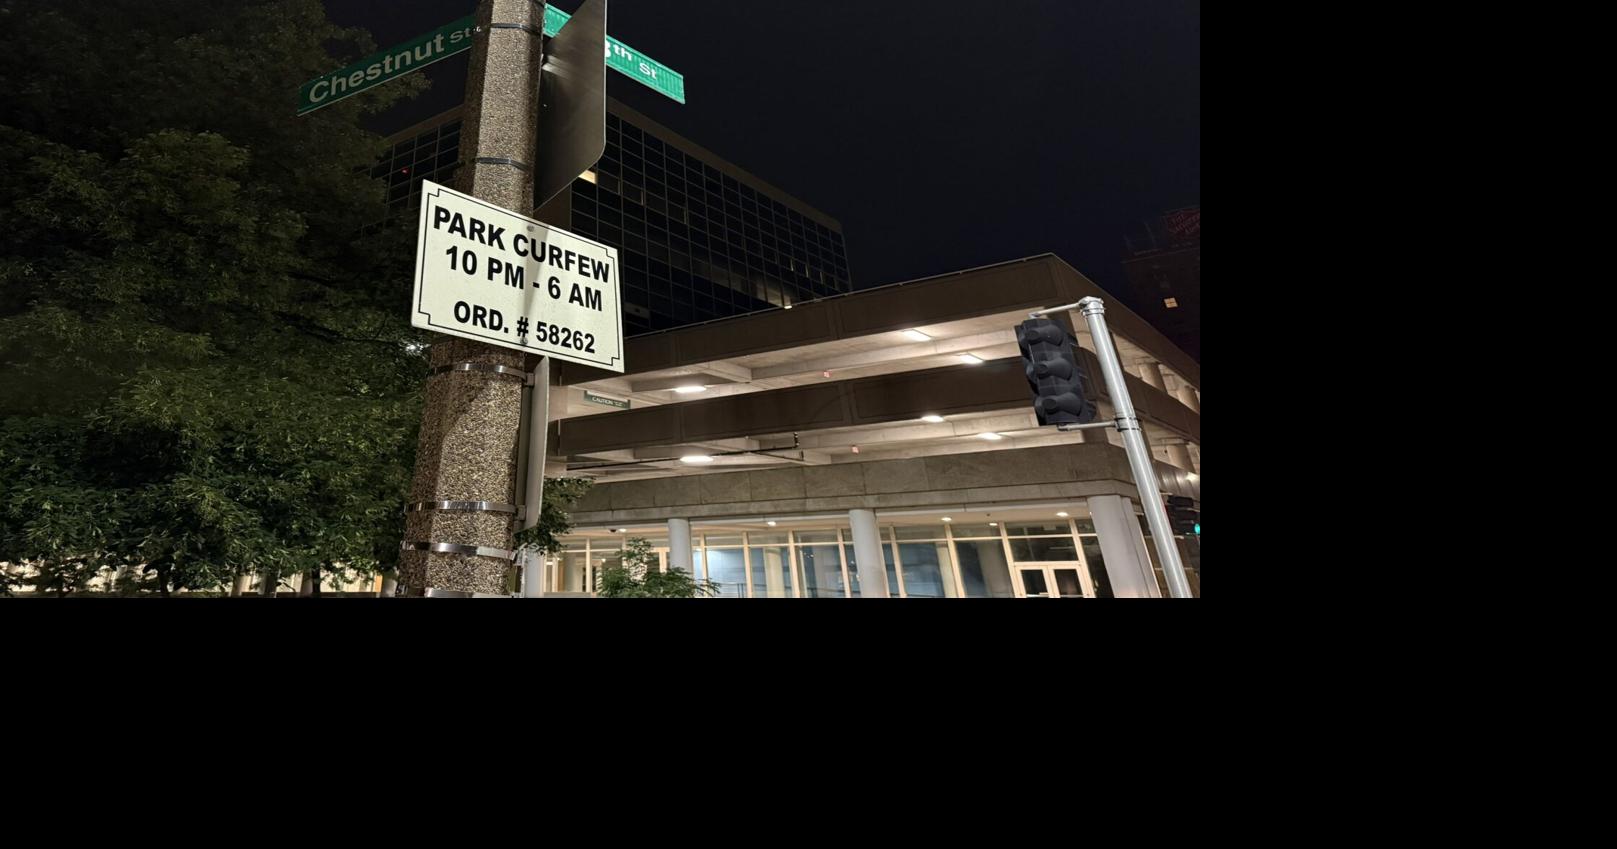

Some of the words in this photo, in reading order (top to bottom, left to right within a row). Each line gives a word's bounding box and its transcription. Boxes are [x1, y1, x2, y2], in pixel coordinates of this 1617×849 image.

[309, 34, 444, 103] Chestnut
[449, 27, 471, 43] St
[640, 62, 656, 79] St
[433, 205, 505, 251] PARK
[513, 233, 609, 283] CURFEW
[446, 245, 477, 275] 10
[487, 256, 524, 290] PM
[548, 276, 561, 300] 6
[568, 283, 602, 312] AM
[454, 300, 509, 333] ORD.
[517, 316, 529, 338] #
[536, 321, 595, 353] 58262
